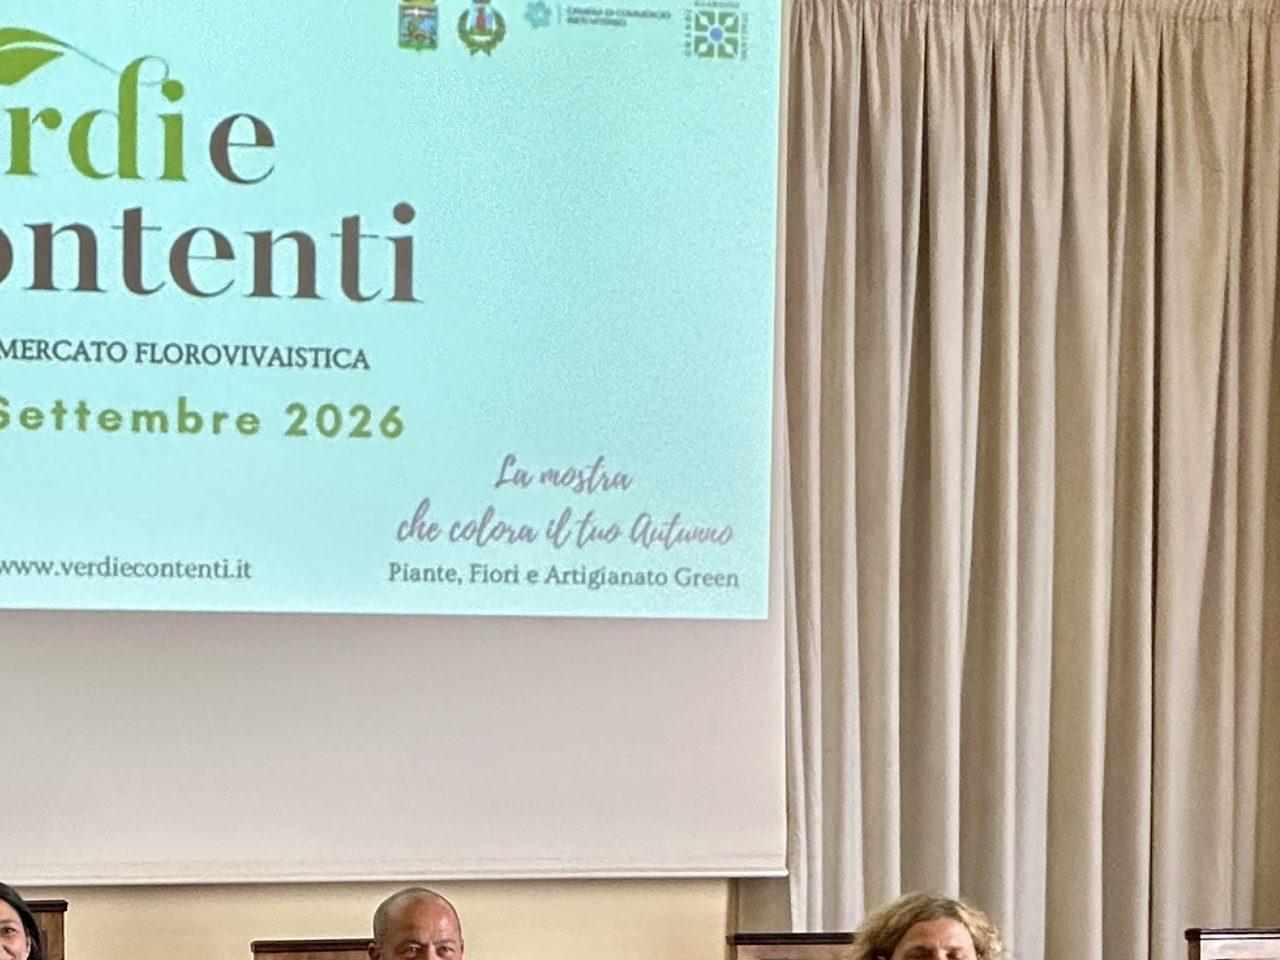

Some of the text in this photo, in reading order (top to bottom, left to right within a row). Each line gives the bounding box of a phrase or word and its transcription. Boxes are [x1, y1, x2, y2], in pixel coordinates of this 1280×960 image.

[209, 112, 276, 185] e
[135, 342, 371, 370] FLOROVIVAISTICA
[284, 402, 405, 439] 2026
[495, 454, 632, 494] La mostra
[396, 497, 734, 551] che colora il tuo Autunno
[388, 562, 740, 590] Piante, Fiori e Artigianato Green
